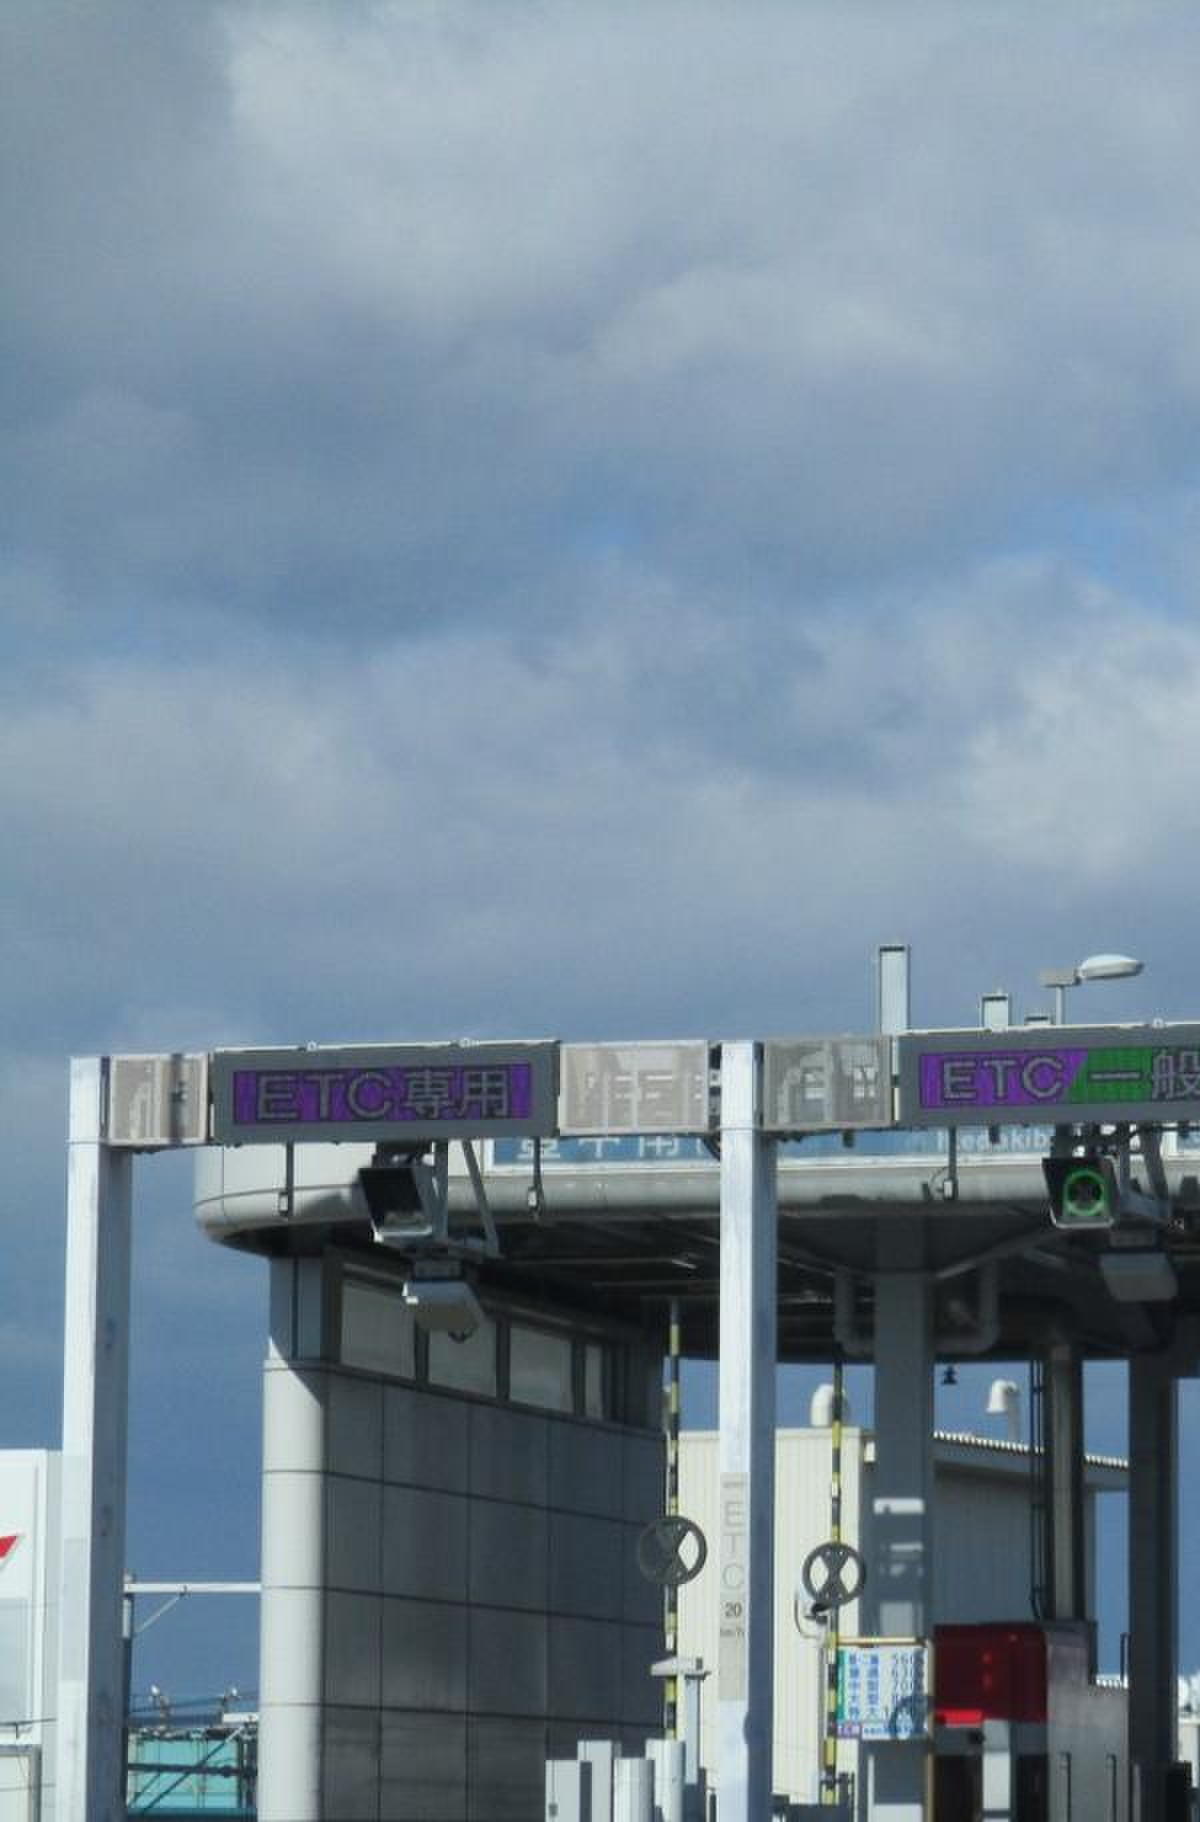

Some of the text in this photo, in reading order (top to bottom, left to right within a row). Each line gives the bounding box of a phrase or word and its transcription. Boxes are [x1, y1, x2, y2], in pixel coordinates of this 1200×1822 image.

[257, 1067, 509, 1120] ETC専用
[942, 1055, 1063, 1100] ETC
[724, 1602, 743, 1617] 20
